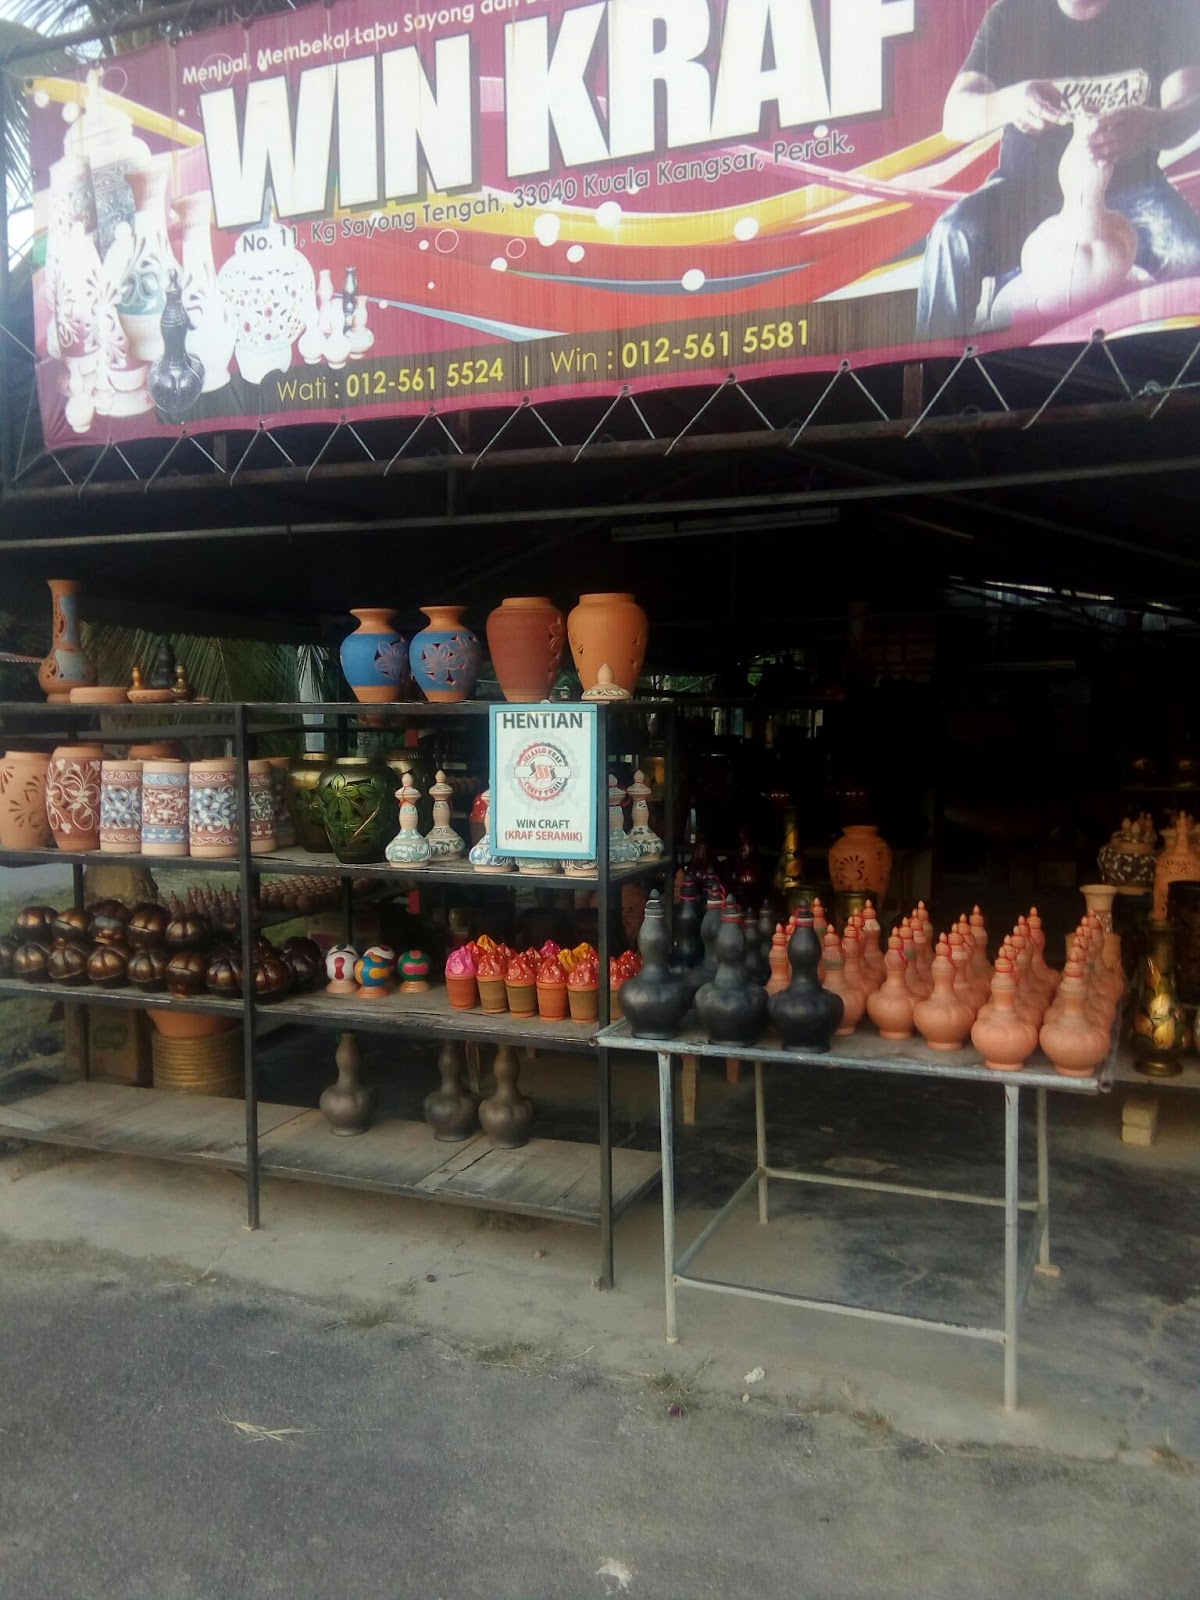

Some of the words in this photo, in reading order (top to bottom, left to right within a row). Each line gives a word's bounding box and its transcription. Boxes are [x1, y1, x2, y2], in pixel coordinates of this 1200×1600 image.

[257, 28, 349, 71] Membekal
[355, 21, 398, 46] Labu
[403, 4, 474, 33] Sayong
[200, 33, 473, 229] WIN
[504, 0, 915, 178] KRAF
[243, 233, 272, 253] No.
[312, 221, 336, 244] Kg
[342, 211, 416, 239] Sayong
[423, 193, 505, 224] Tengah,
[513, 178, 577, 209] 33040
[584, 168, 649, 197] Kuala
[658, 150, 765, 184] Kangsar,
[773, 131, 854, 164] Perak.
[277, 376, 327, 402] Wati
[346, 366, 436, 398] 012-561
[446, 357, 504, 388] 5524
[550, 347, 597, 374] Win
[622, 331, 729, 369] 012-561
[742, 319, 808, 353] 5581
[503, 712, 583, 729] HENTIAN
[505, 830, 533, 841] (KRAF
[535, 831, 582, 843] SERAMIK)
[516, 819, 536, 829] WIN
[538, 819, 570, 829] CRAFT
